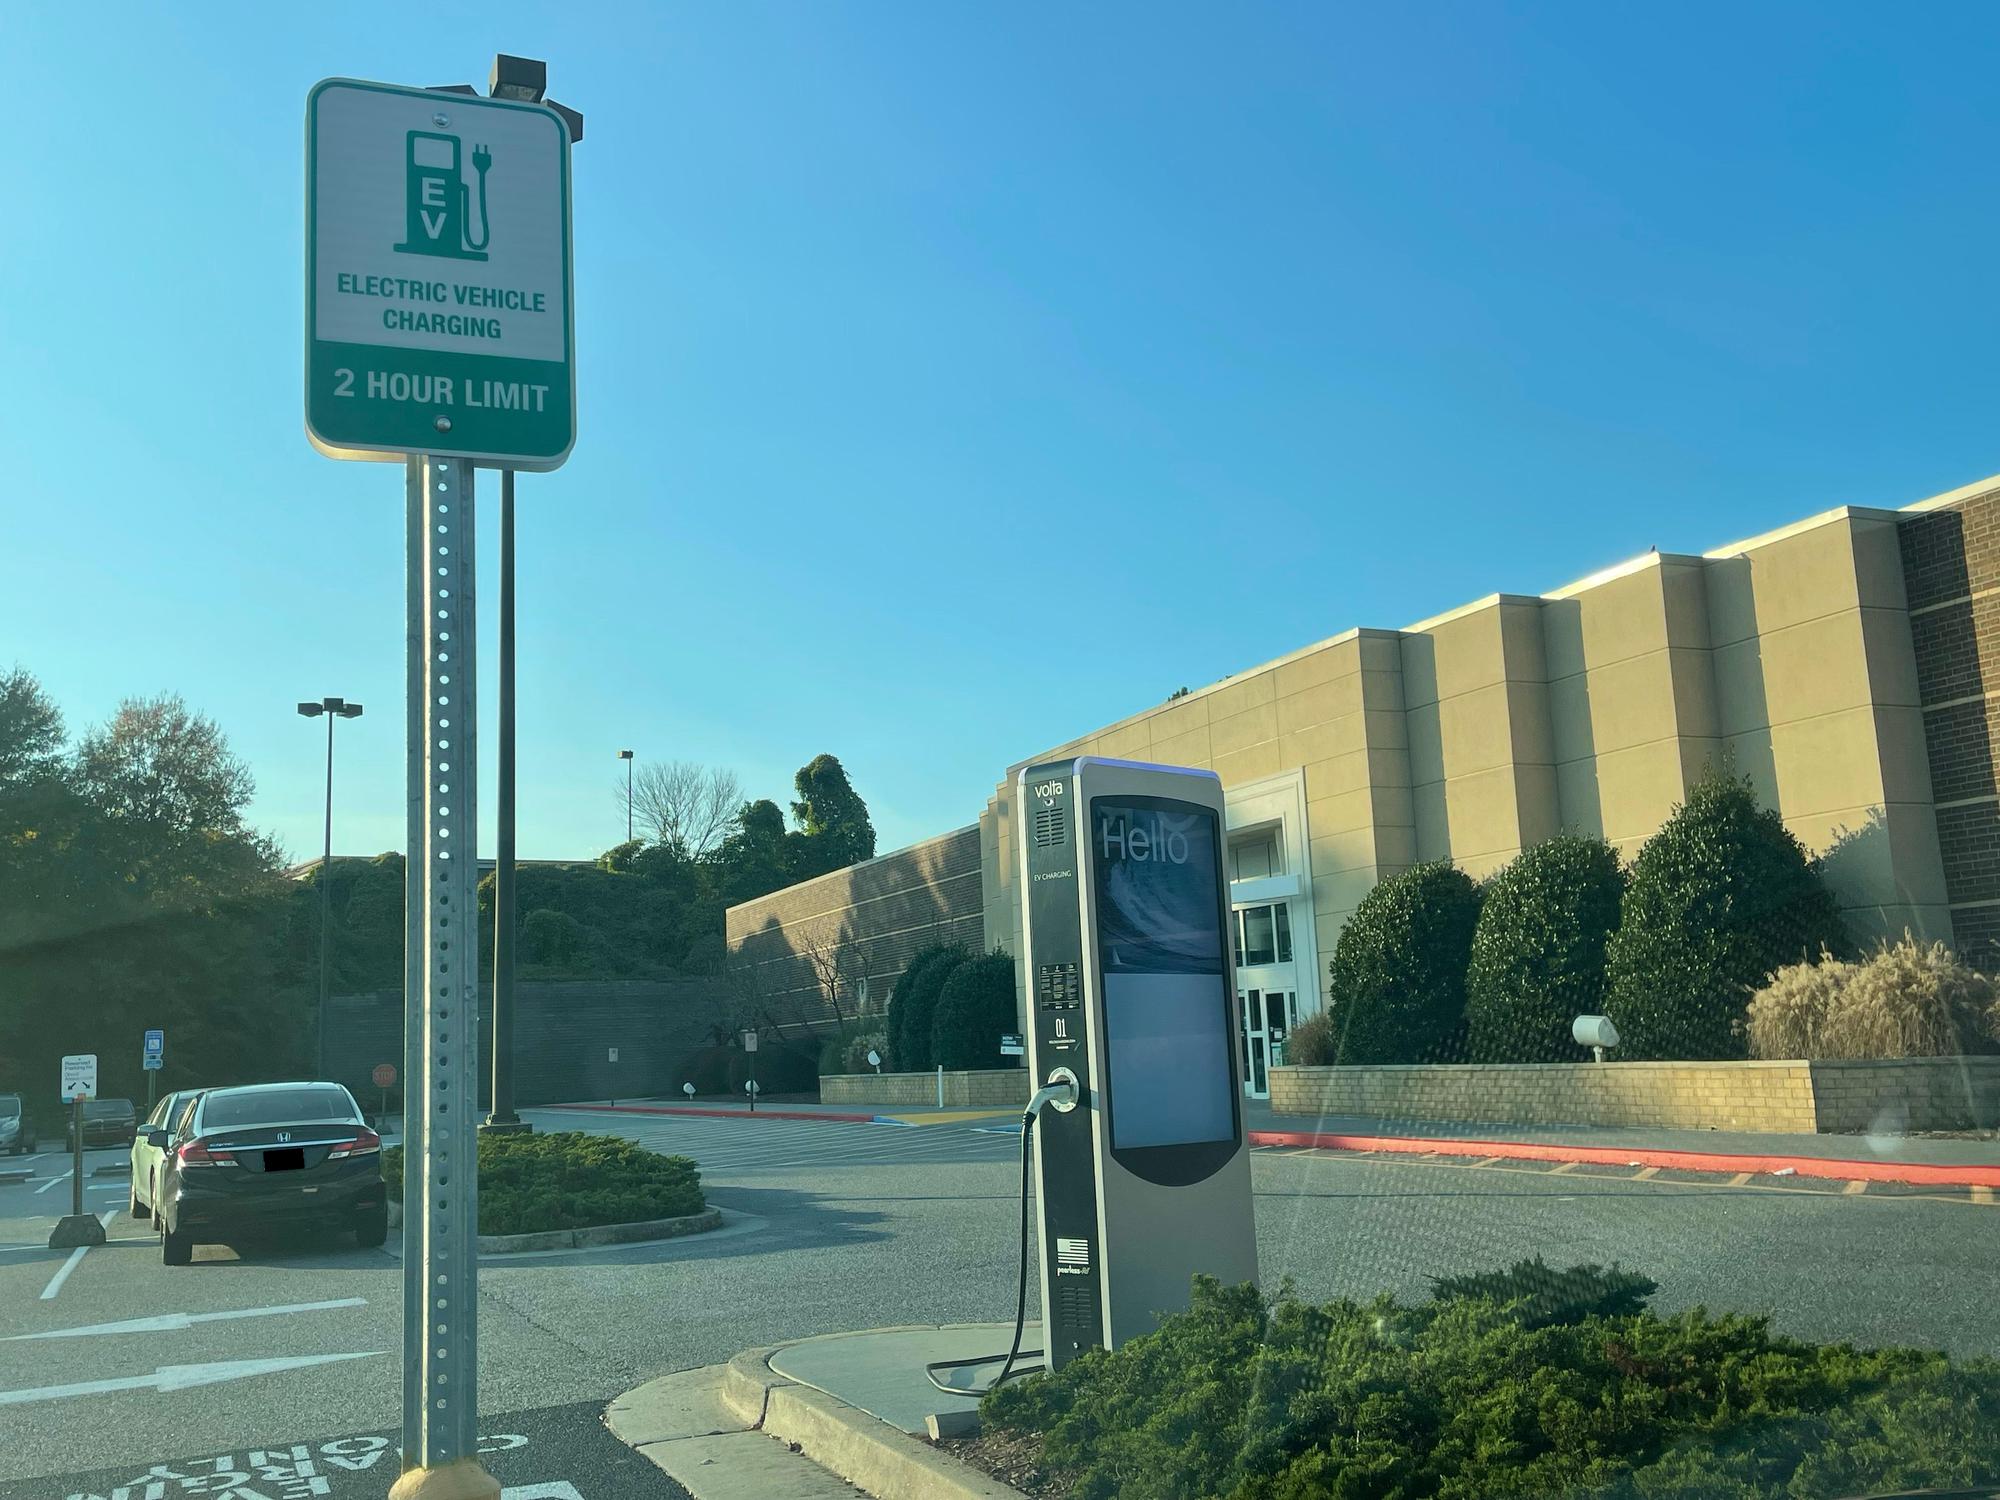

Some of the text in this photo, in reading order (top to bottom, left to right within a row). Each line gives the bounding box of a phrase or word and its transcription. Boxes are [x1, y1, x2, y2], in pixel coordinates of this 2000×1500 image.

[420, 176, 446, 240] EV
[337, 272, 546, 313] ELECTRIC VEHICLE
[383, 308, 501, 339] CHARGING
[333, 367, 549, 412] 2 HOUR LIMIT
[1034, 780, 1063, 798] volta
[1102, 818, 1189, 864] Hello
[1041, 869, 1072, 880] CHARGING
[1055, 1018, 1067, 1038] 01
[125, 1436, 390, 1487] ONLY
